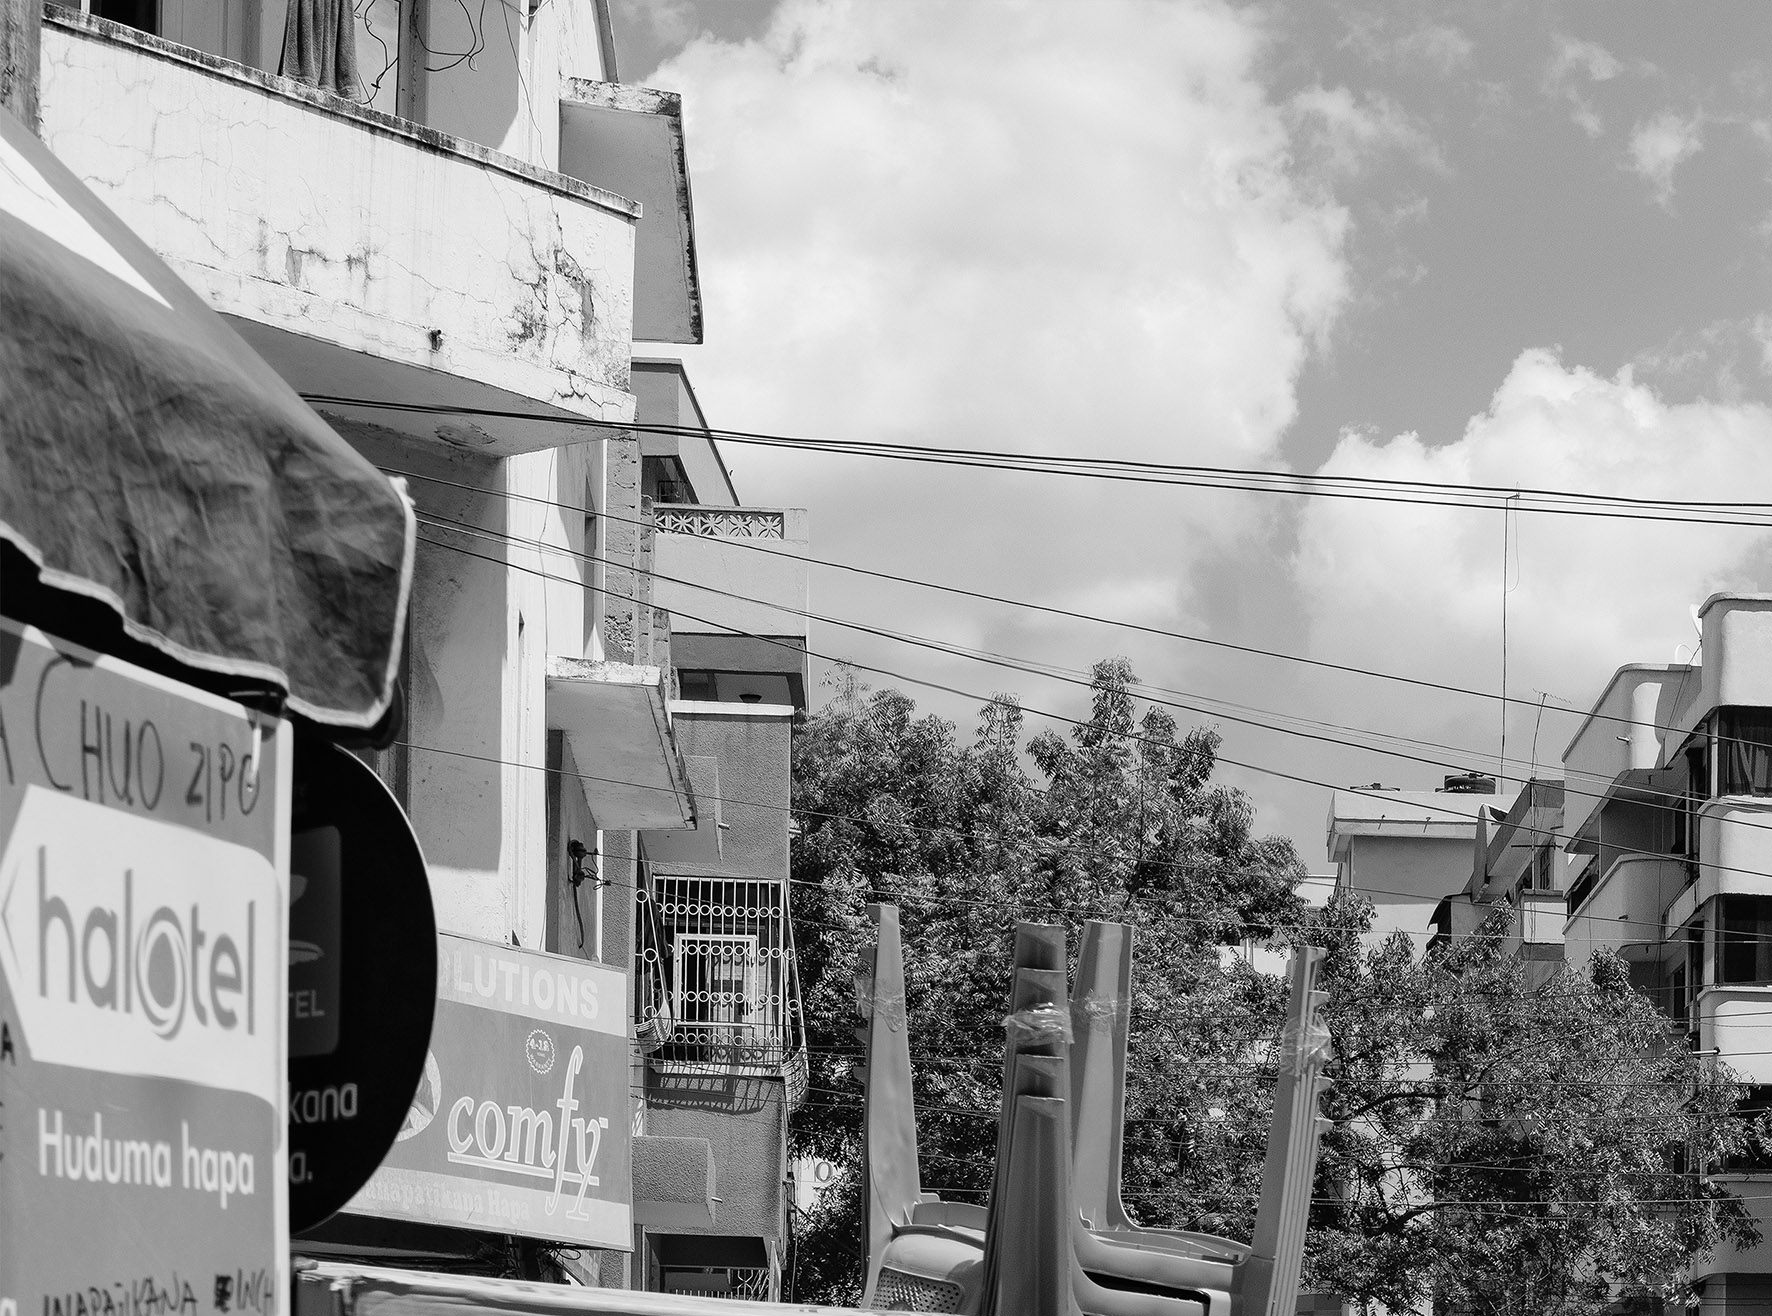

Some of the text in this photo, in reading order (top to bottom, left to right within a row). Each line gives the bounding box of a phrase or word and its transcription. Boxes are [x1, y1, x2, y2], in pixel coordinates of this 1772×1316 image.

[35, 653, 164, 811] CHUO
[37, 844, 256, 1041] halotel
[38, 1107, 255, 1210] Huduma hapa
[447, 1044, 608, 1222] comfy
